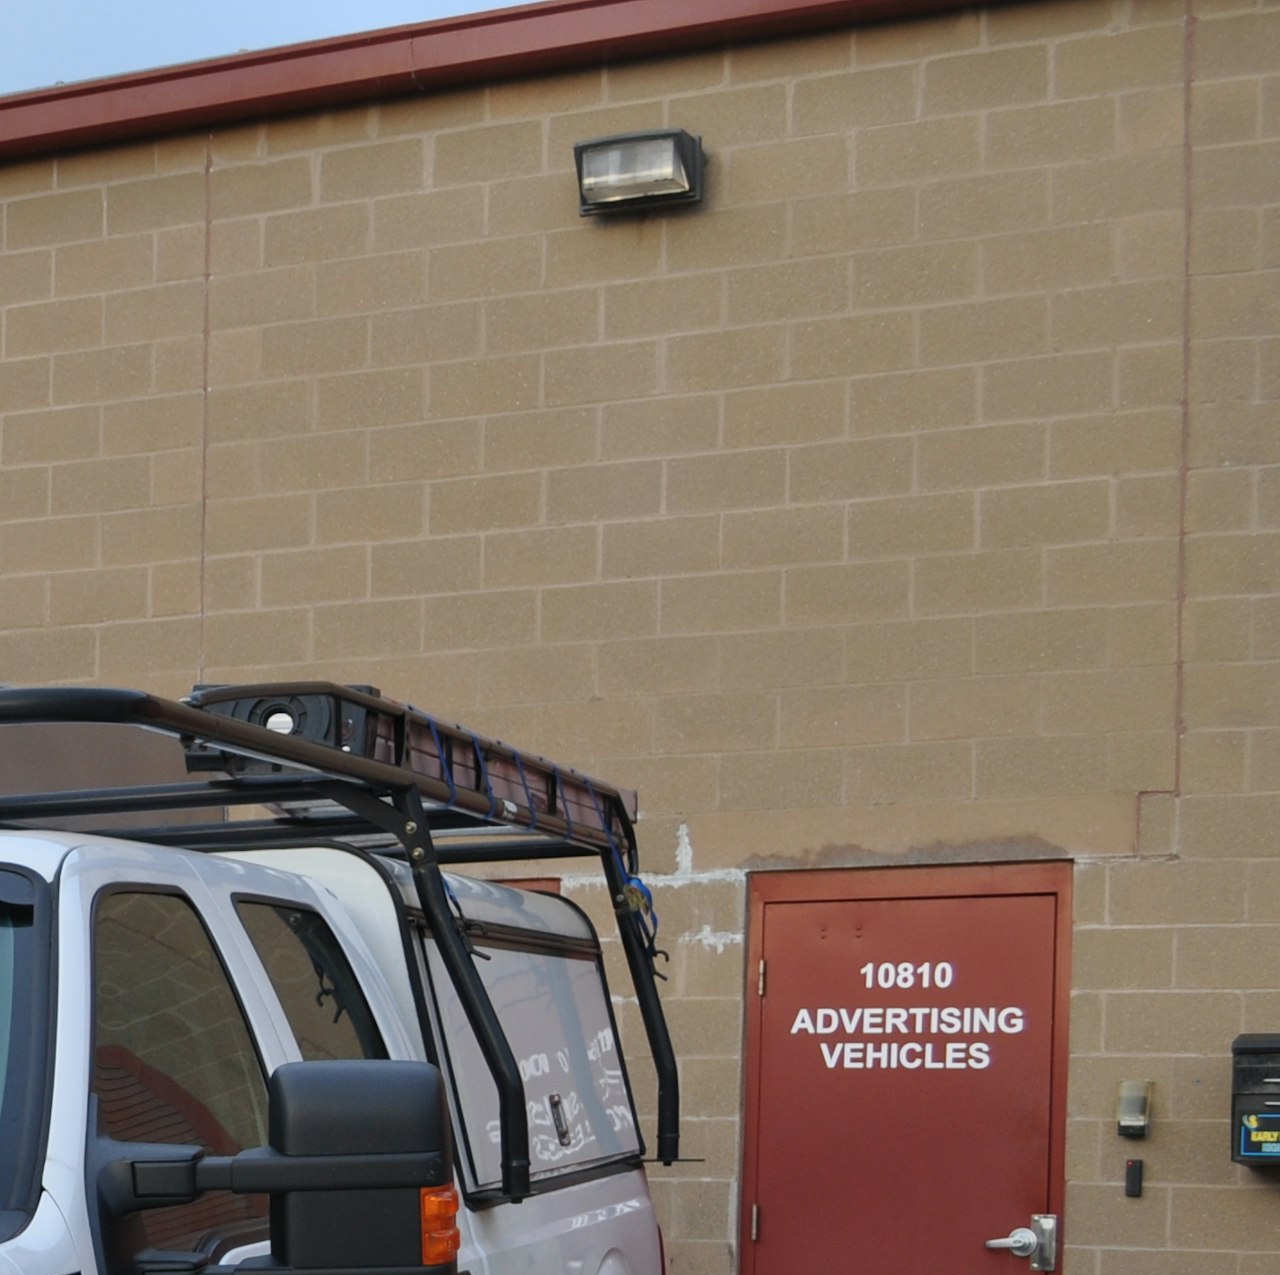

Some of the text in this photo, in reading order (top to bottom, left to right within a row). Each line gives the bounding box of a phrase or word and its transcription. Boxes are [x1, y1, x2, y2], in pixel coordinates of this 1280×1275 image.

[860, 961, 953, 989] 10810
[790, 1006, 1025, 1035] ADVERTISING
[820, 1042, 991, 1070] VEHICLES
